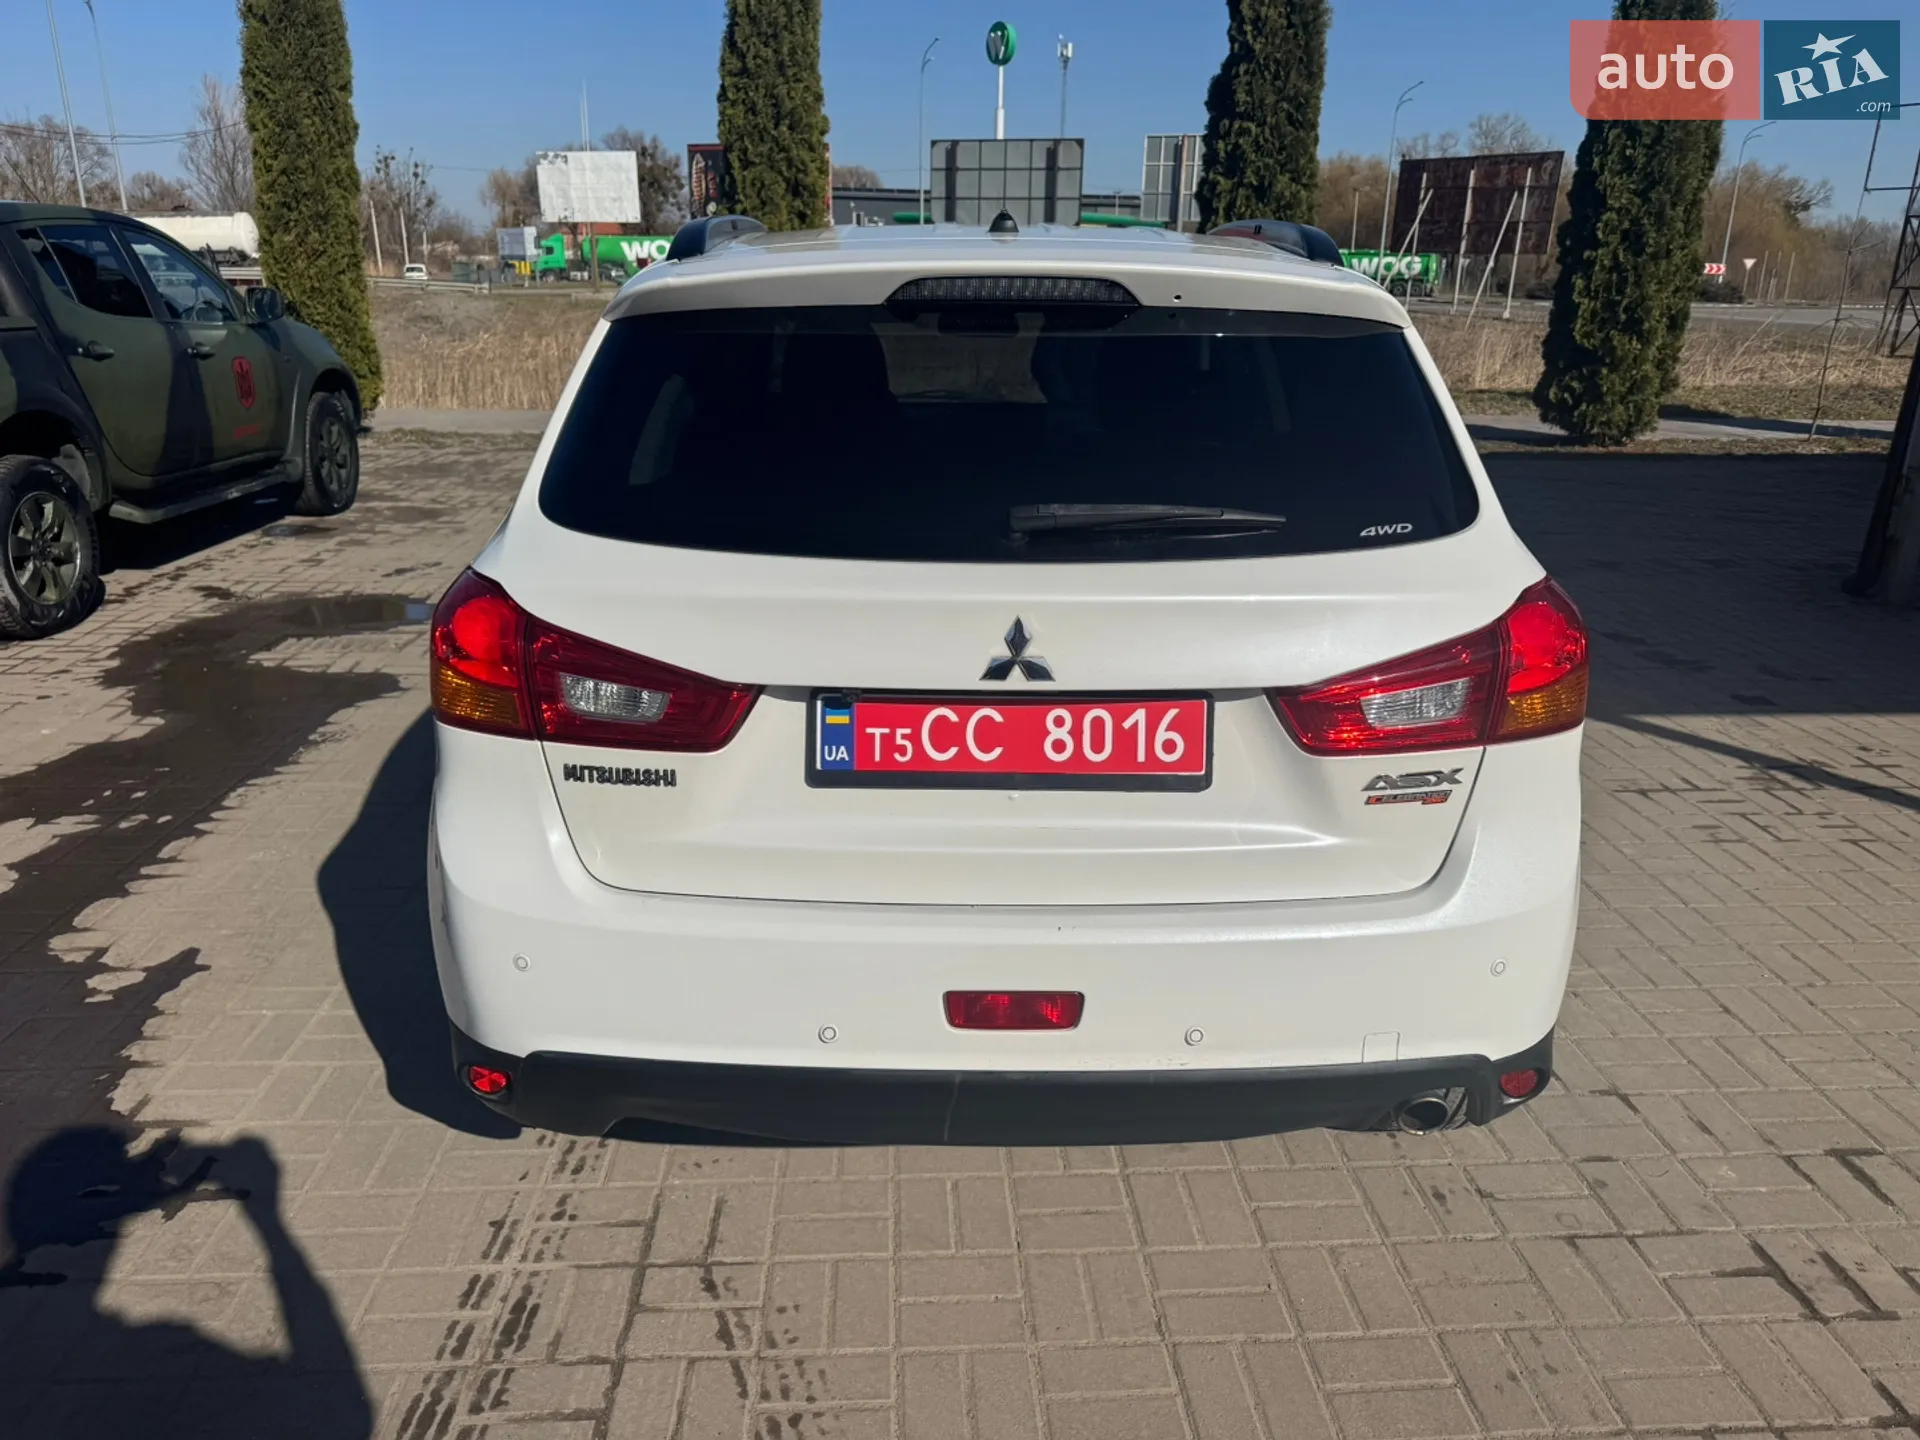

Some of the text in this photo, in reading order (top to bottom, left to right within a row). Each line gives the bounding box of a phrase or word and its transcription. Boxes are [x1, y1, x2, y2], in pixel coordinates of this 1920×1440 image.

[620, 239, 671, 262] WO
[1351, 255, 1422, 277] WOG
[1360, 523, 1413, 537] 4WD
[1043, 707, 1185, 763] 8016
[824, 745, 849, 762] UA
[562, 762, 677, 787] MITSUBISHI
[1361, 767, 1464, 792] ASX
